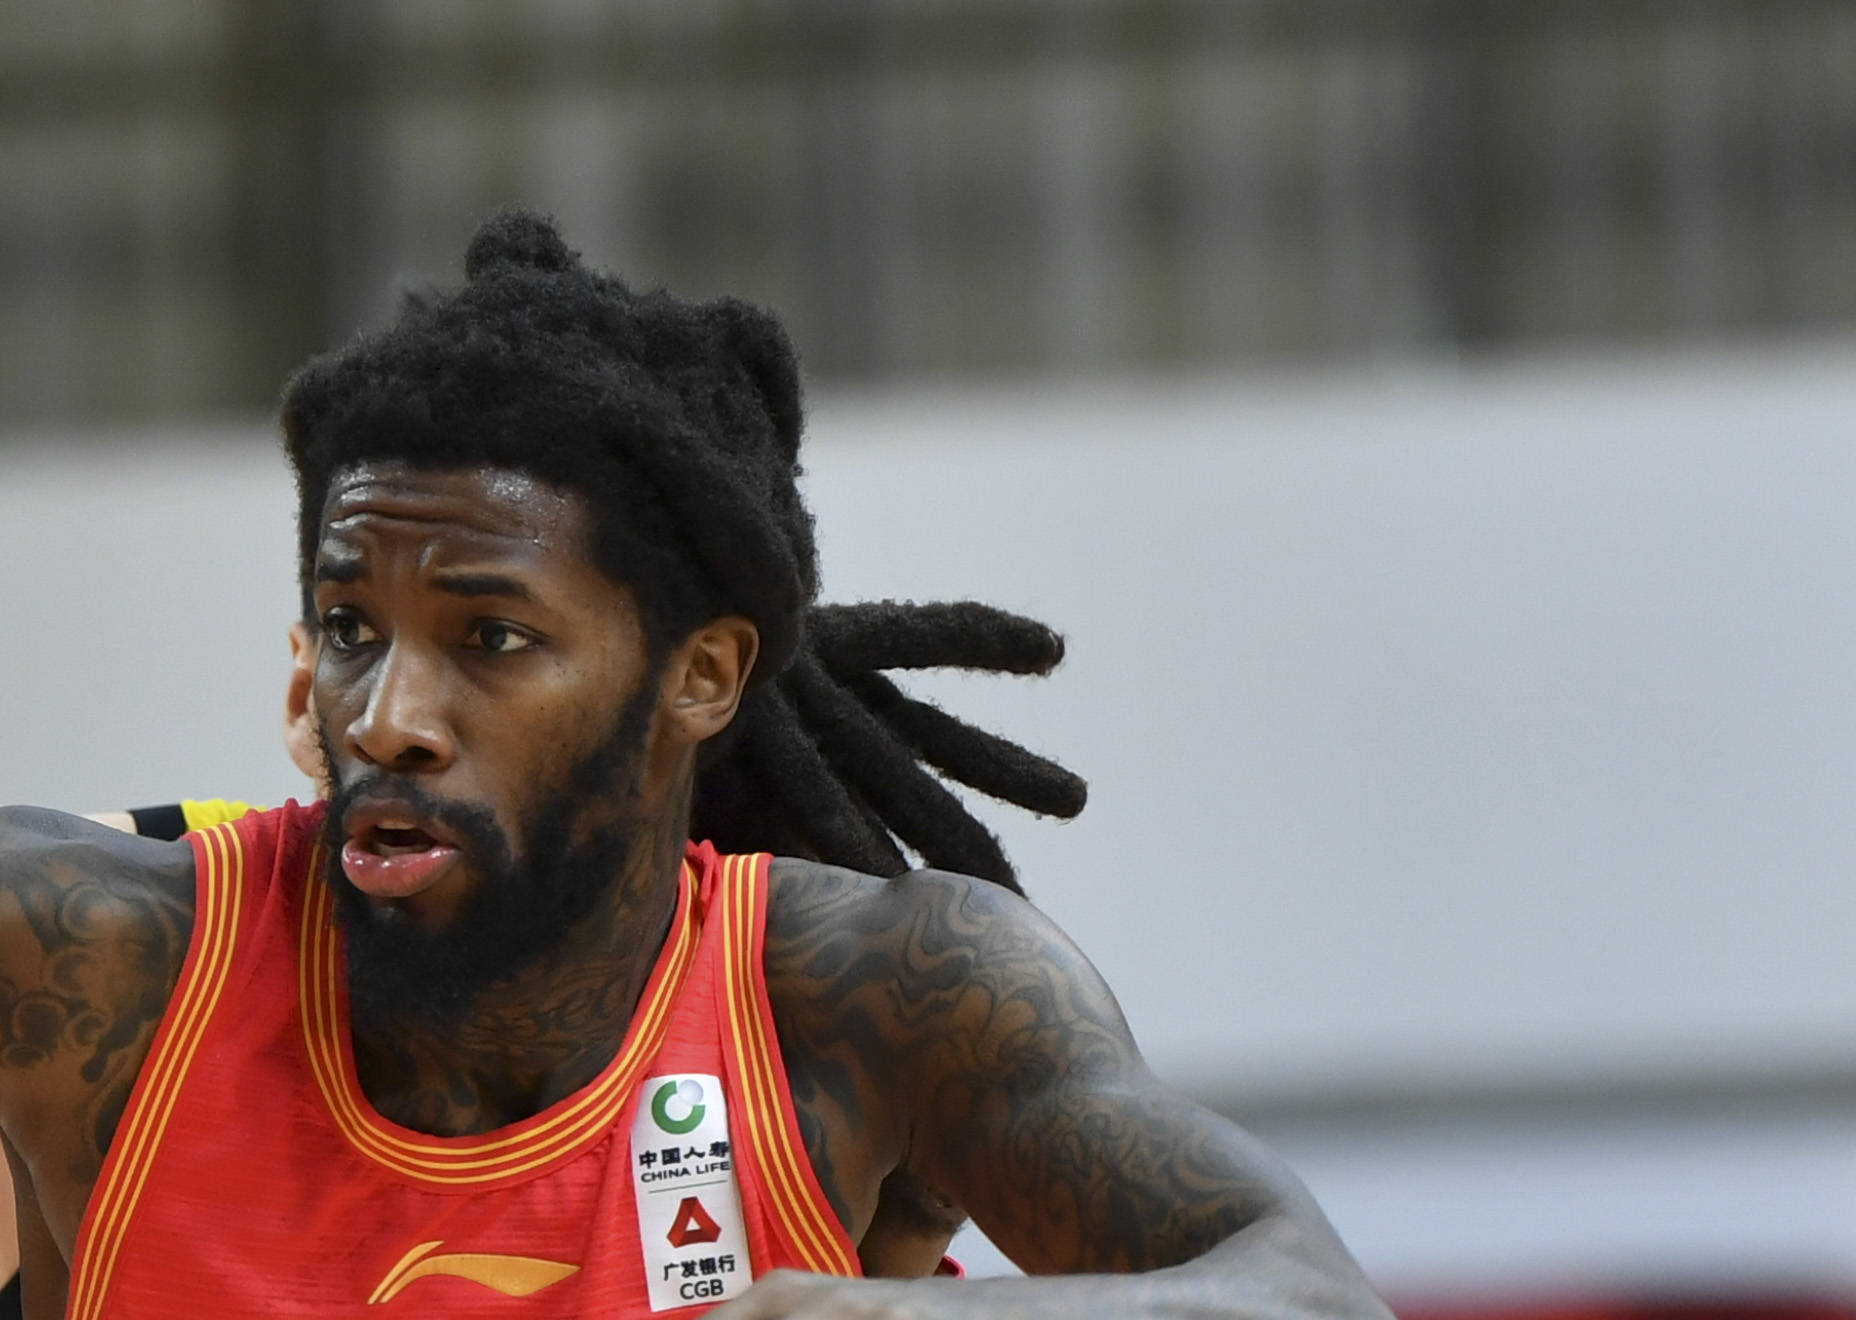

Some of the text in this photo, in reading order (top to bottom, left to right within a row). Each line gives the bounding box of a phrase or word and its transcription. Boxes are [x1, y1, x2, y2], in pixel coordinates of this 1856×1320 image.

[639, 1141, 730, 1169] 中国人寿
[640, 1161, 731, 1183] CHINA LIFE
[663, 1254, 736, 1281] 广发银行
[679, 1279, 724, 1300] CGB
